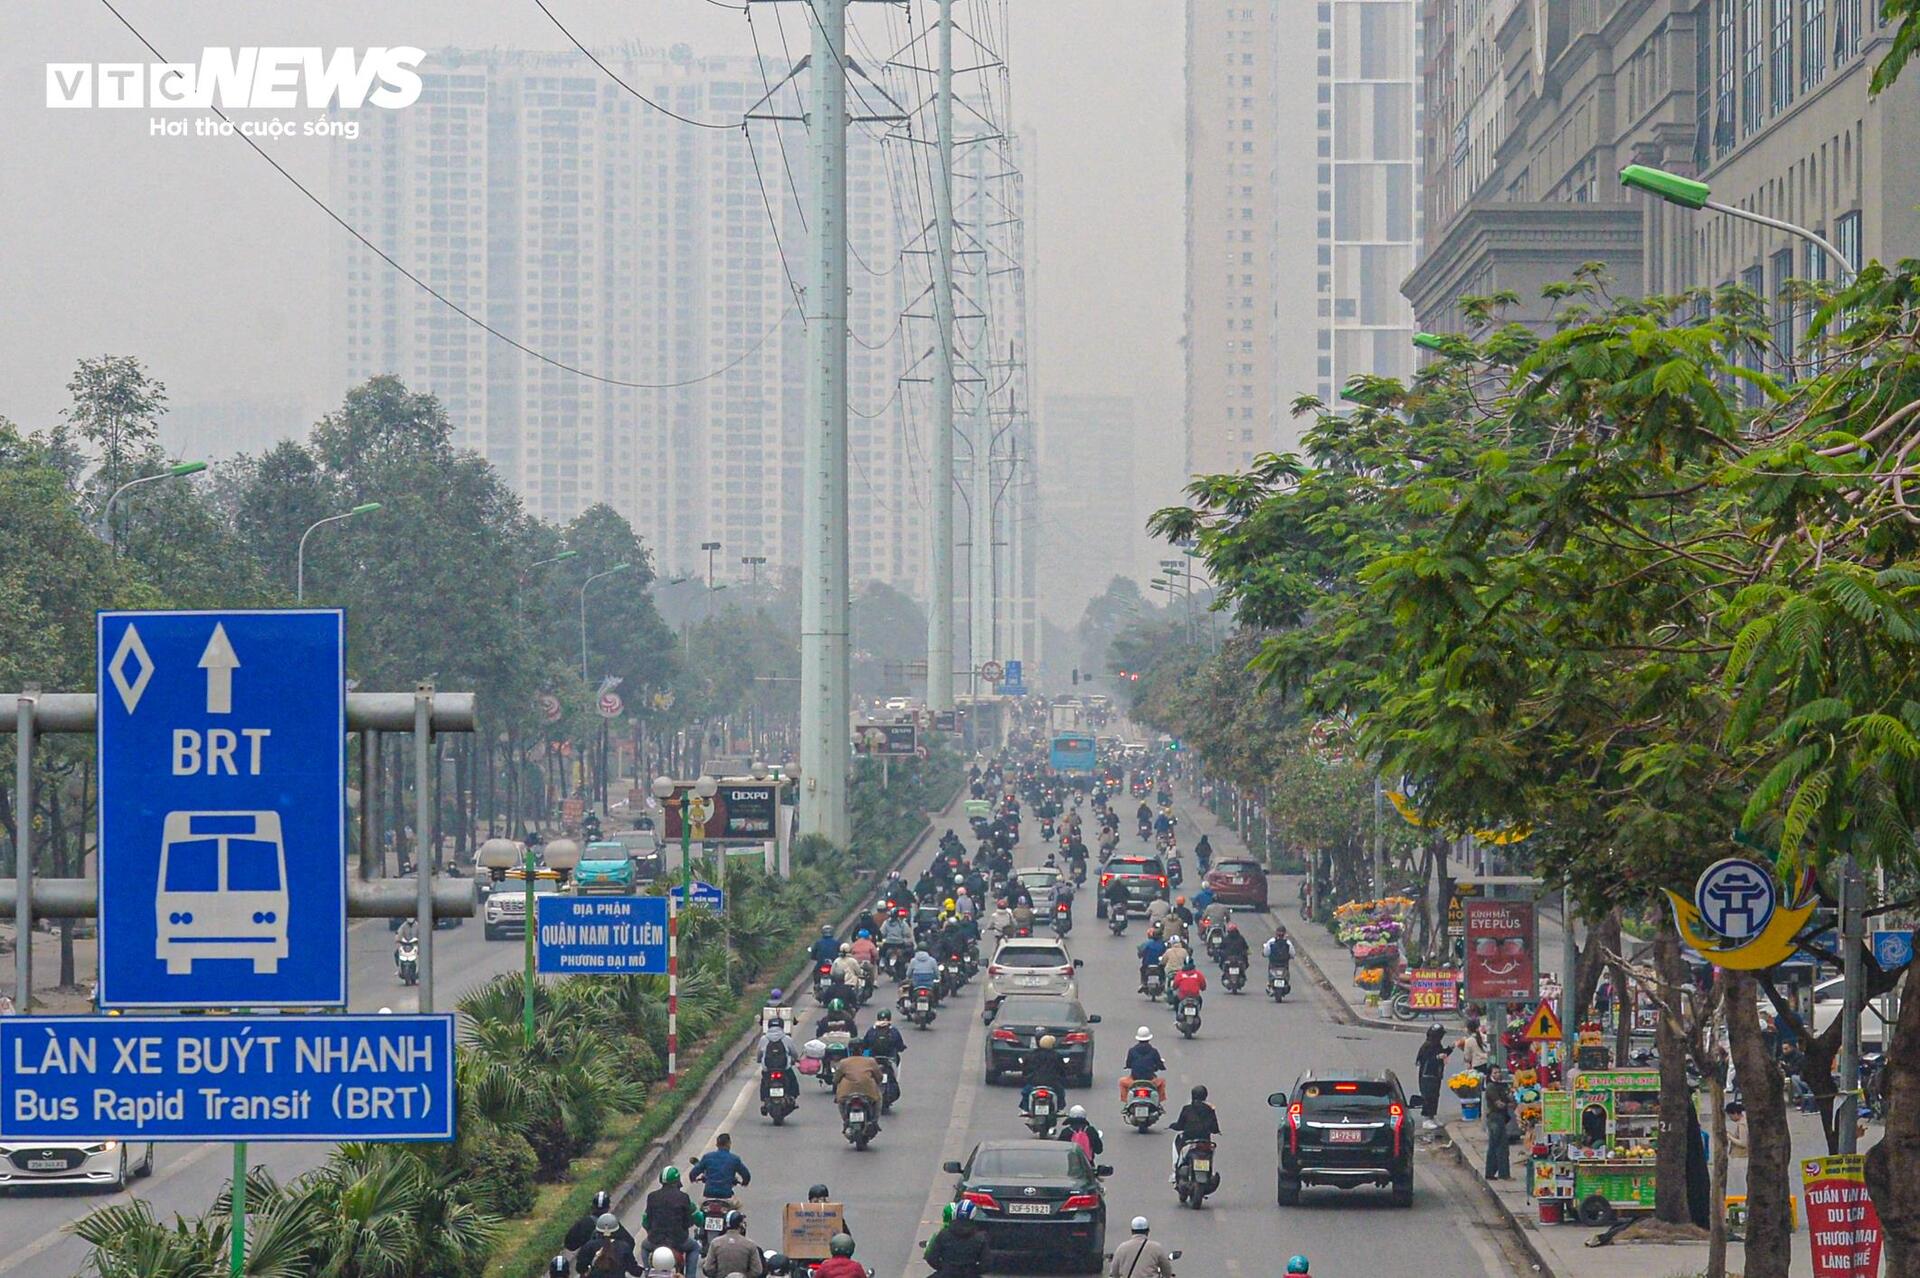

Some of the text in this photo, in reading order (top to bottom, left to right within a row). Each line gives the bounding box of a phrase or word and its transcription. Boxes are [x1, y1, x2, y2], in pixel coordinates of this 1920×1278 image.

[172, 728, 271, 776] BRT
[597, 901, 630, 917] PHẬN
[542, 922, 576, 948] QUẬN
[580, 925, 609, 945] NAM
[633, 922, 663, 945] LIÊM
[1414, 989, 1442, 1007] XÔI
[15, 1026, 432, 1074] LÀN XE BUÝT NHANH
[15, 1083, 431, 1129] Bus Rapid Transit (BRT)
[1821, 1251, 1850, 1269] LÀNG
